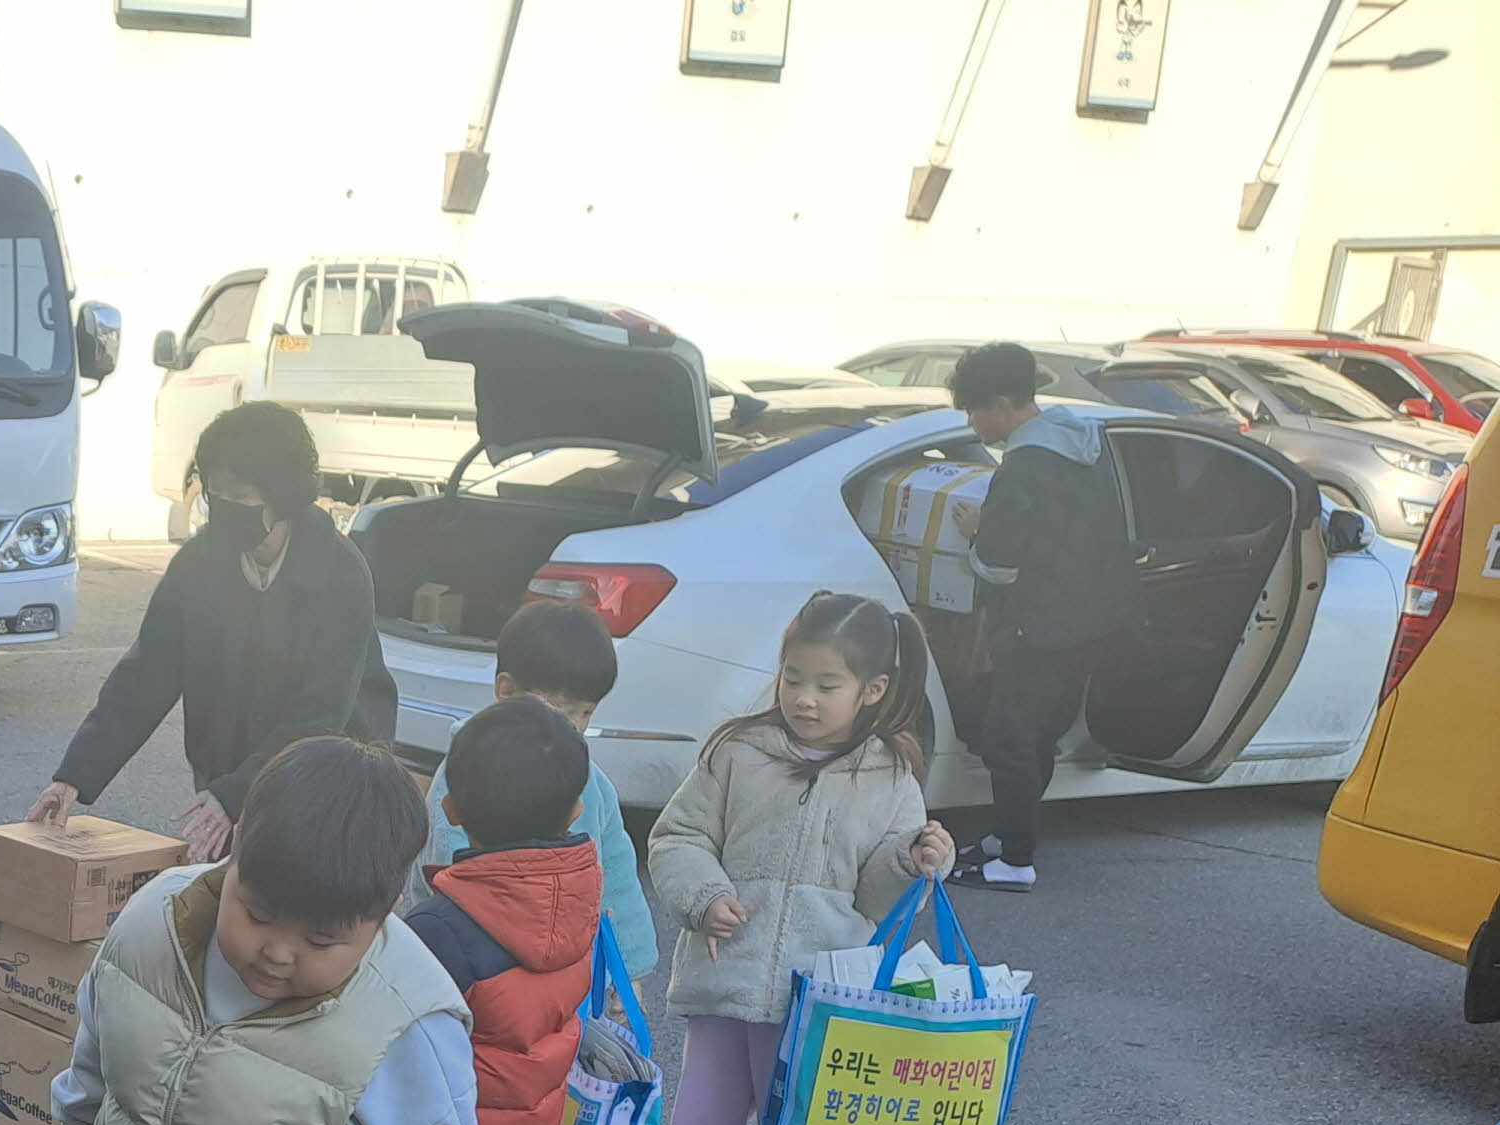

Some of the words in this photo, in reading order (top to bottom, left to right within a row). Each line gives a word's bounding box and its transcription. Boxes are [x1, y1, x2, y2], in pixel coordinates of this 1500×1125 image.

[4, 972, 76, 1015] MegaCoffee
[826, 1048, 881, 1085] 우리는
[892, 1058, 997, 1091] 매화어린이집
[823, 1089, 920, 1124] 환경히어로
